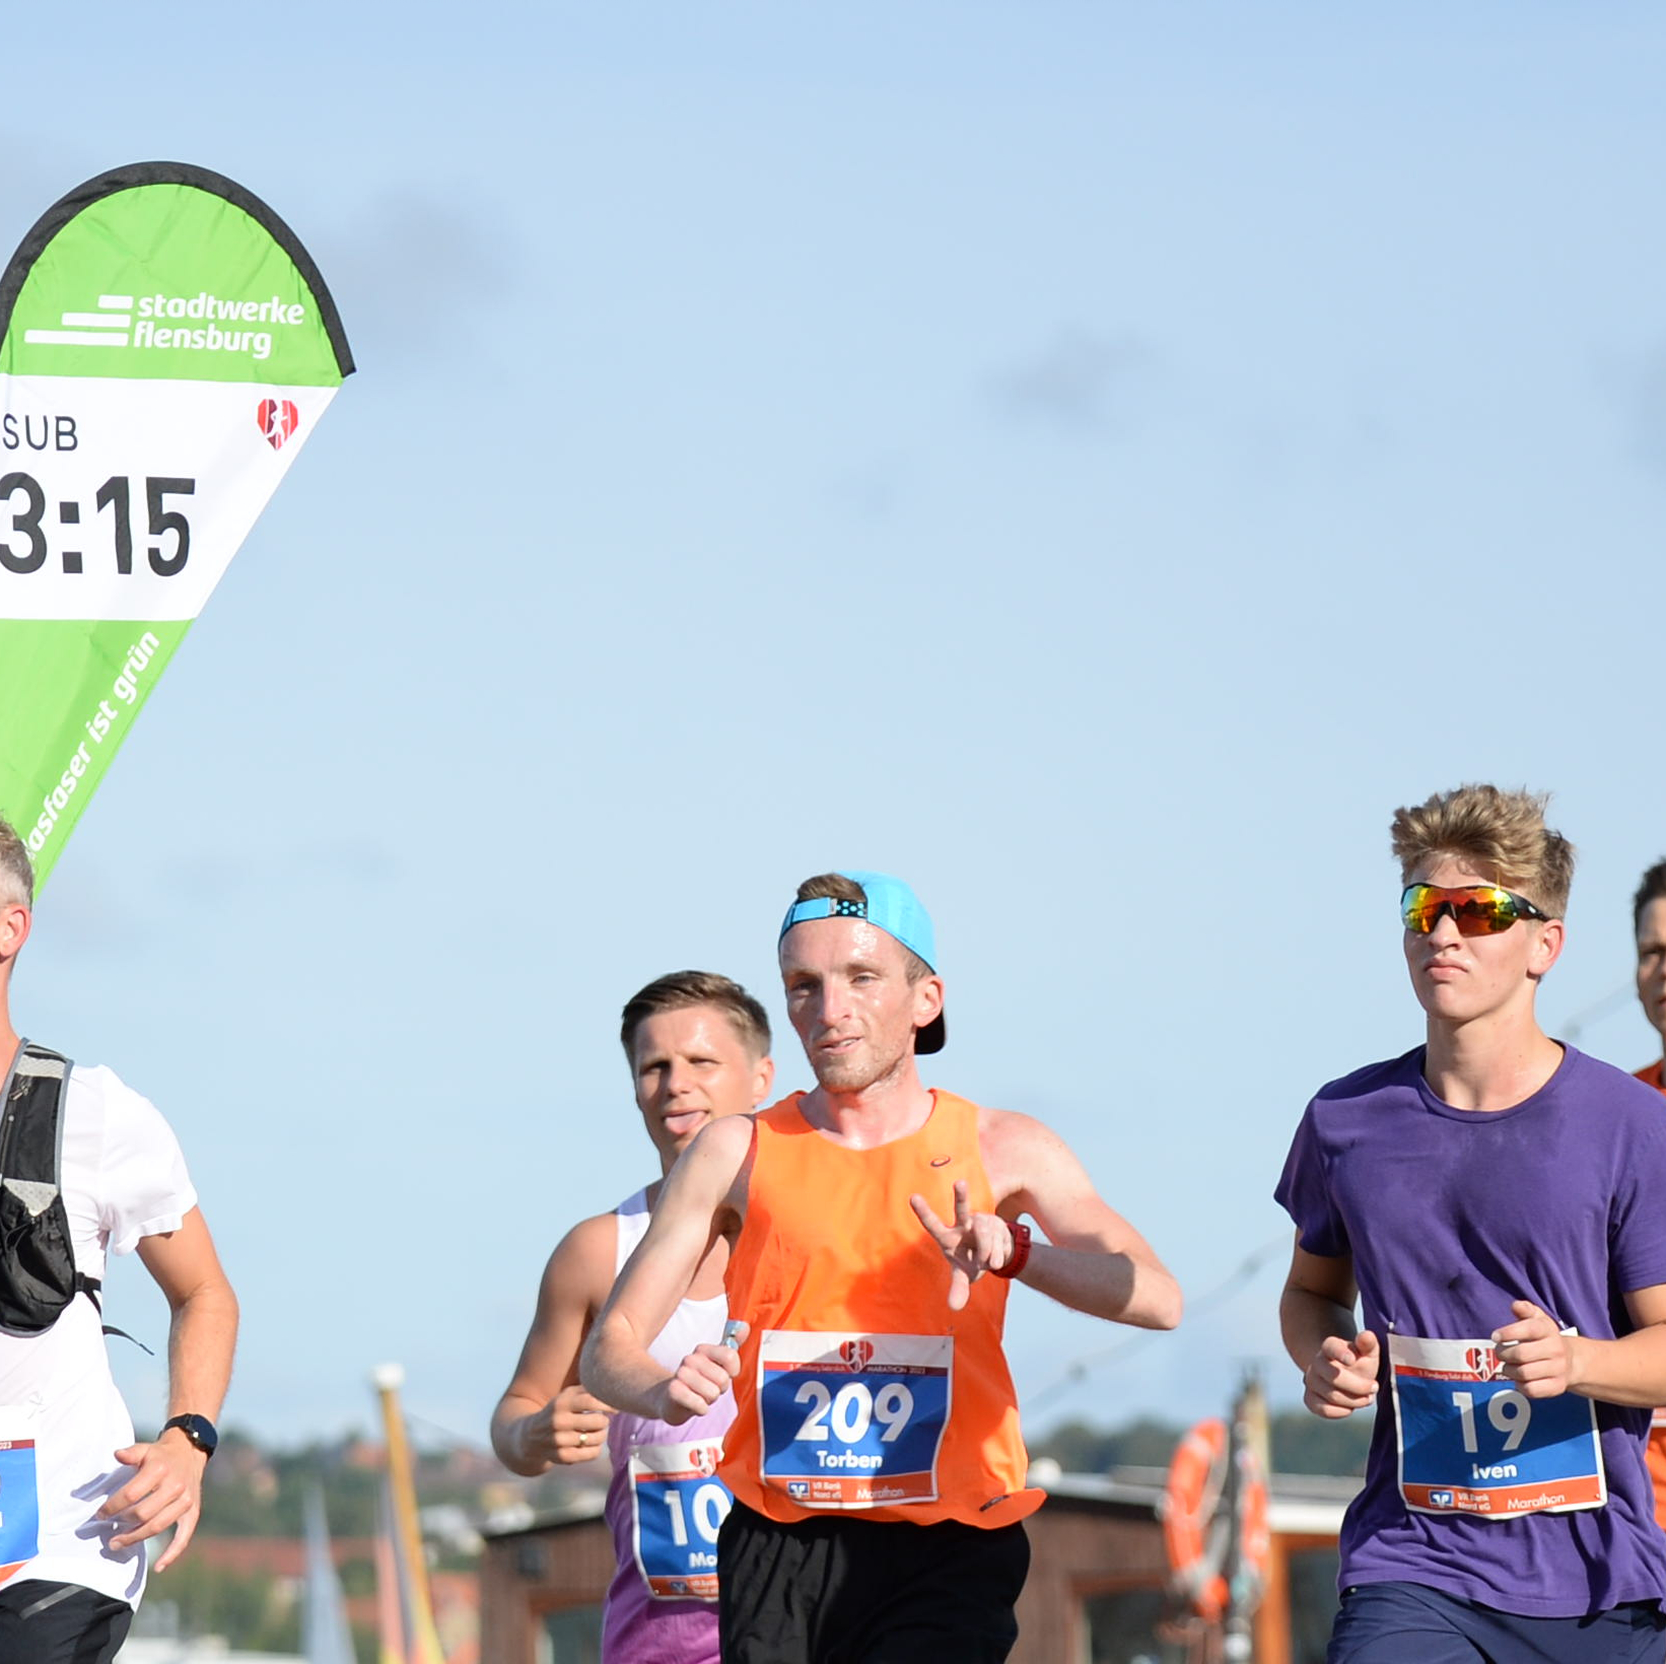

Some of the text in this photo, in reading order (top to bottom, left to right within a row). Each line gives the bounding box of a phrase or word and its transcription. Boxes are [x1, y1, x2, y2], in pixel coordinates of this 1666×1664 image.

[137, 293, 304, 326] stadtwerke
[133, 321, 272, 359] flensburg
[2, 414, 79, 451] SUB
[21, 631, 160, 861] asfaser ist grün
[794, 1380, 914, 1444] 209
[1452, 1389, 1532, 1453] 19
[816, 1449, 883, 1469] Torben
[1472, 1463, 1517, 1480] Iven
[856, 1485, 906, 1500] Marathon
[1507, 1493, 1565, 1510] Marathon
